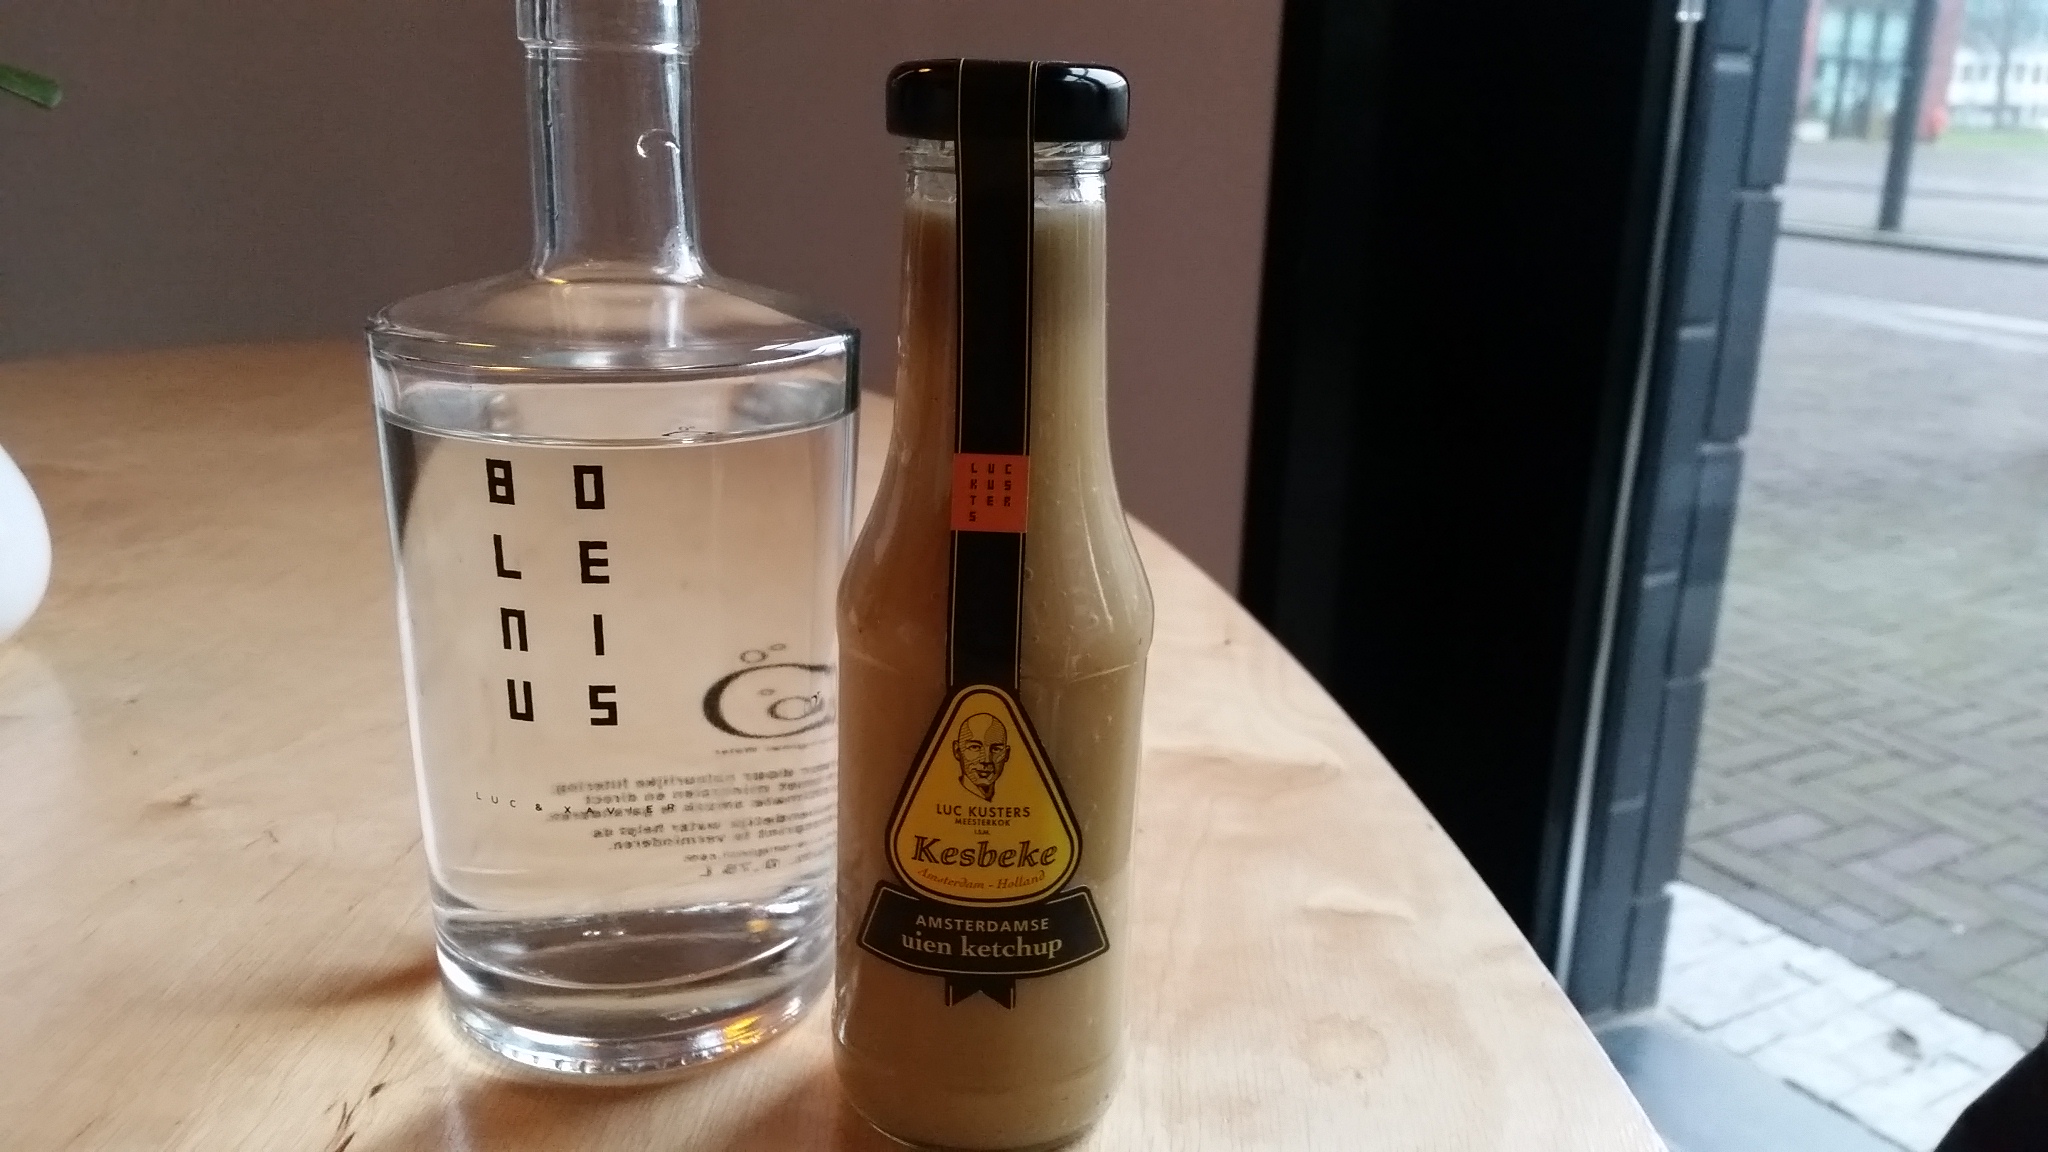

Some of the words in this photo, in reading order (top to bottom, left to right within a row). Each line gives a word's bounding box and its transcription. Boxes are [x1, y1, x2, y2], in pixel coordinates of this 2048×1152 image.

[936, 803, 962, 817] LUC
[968, 806, 1031, 818] KUSTERS
[955, 817, 1011, 827] MEESTERKOK
[911, 834, 1058, 868] Kesbeke
[917, 867, 985, 890] Amsterdam
[997, 869, 1046, 890] Holland
[915, 914, 1050, 933] AMSTERDAMSE
[901, 930, 952, 956] uien
[960, 935, 1063, 960] ketchup
